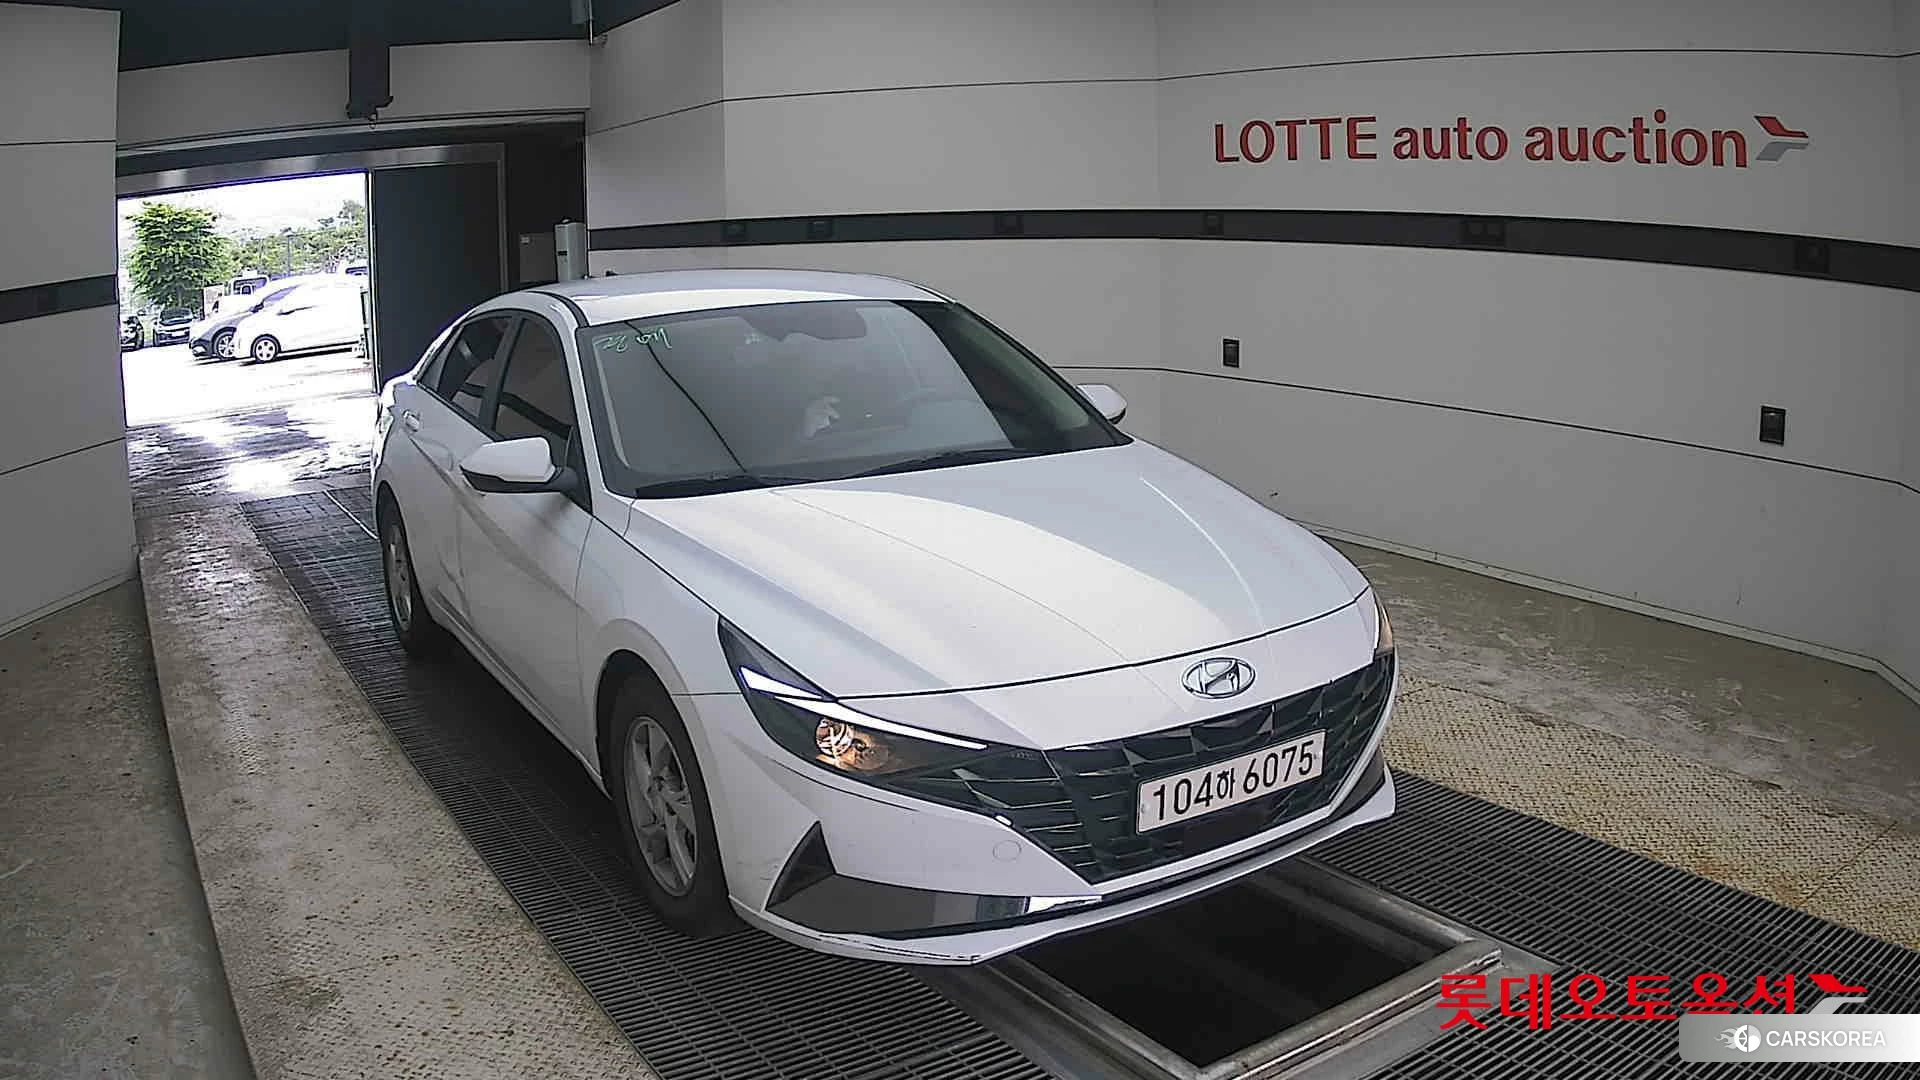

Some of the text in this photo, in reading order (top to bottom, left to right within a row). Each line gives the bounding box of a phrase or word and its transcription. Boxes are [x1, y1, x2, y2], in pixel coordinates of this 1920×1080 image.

[1214, 109, 1749, 168] LOTTE auto auction
[1152, 740, 1315, 821] 104하 6075
